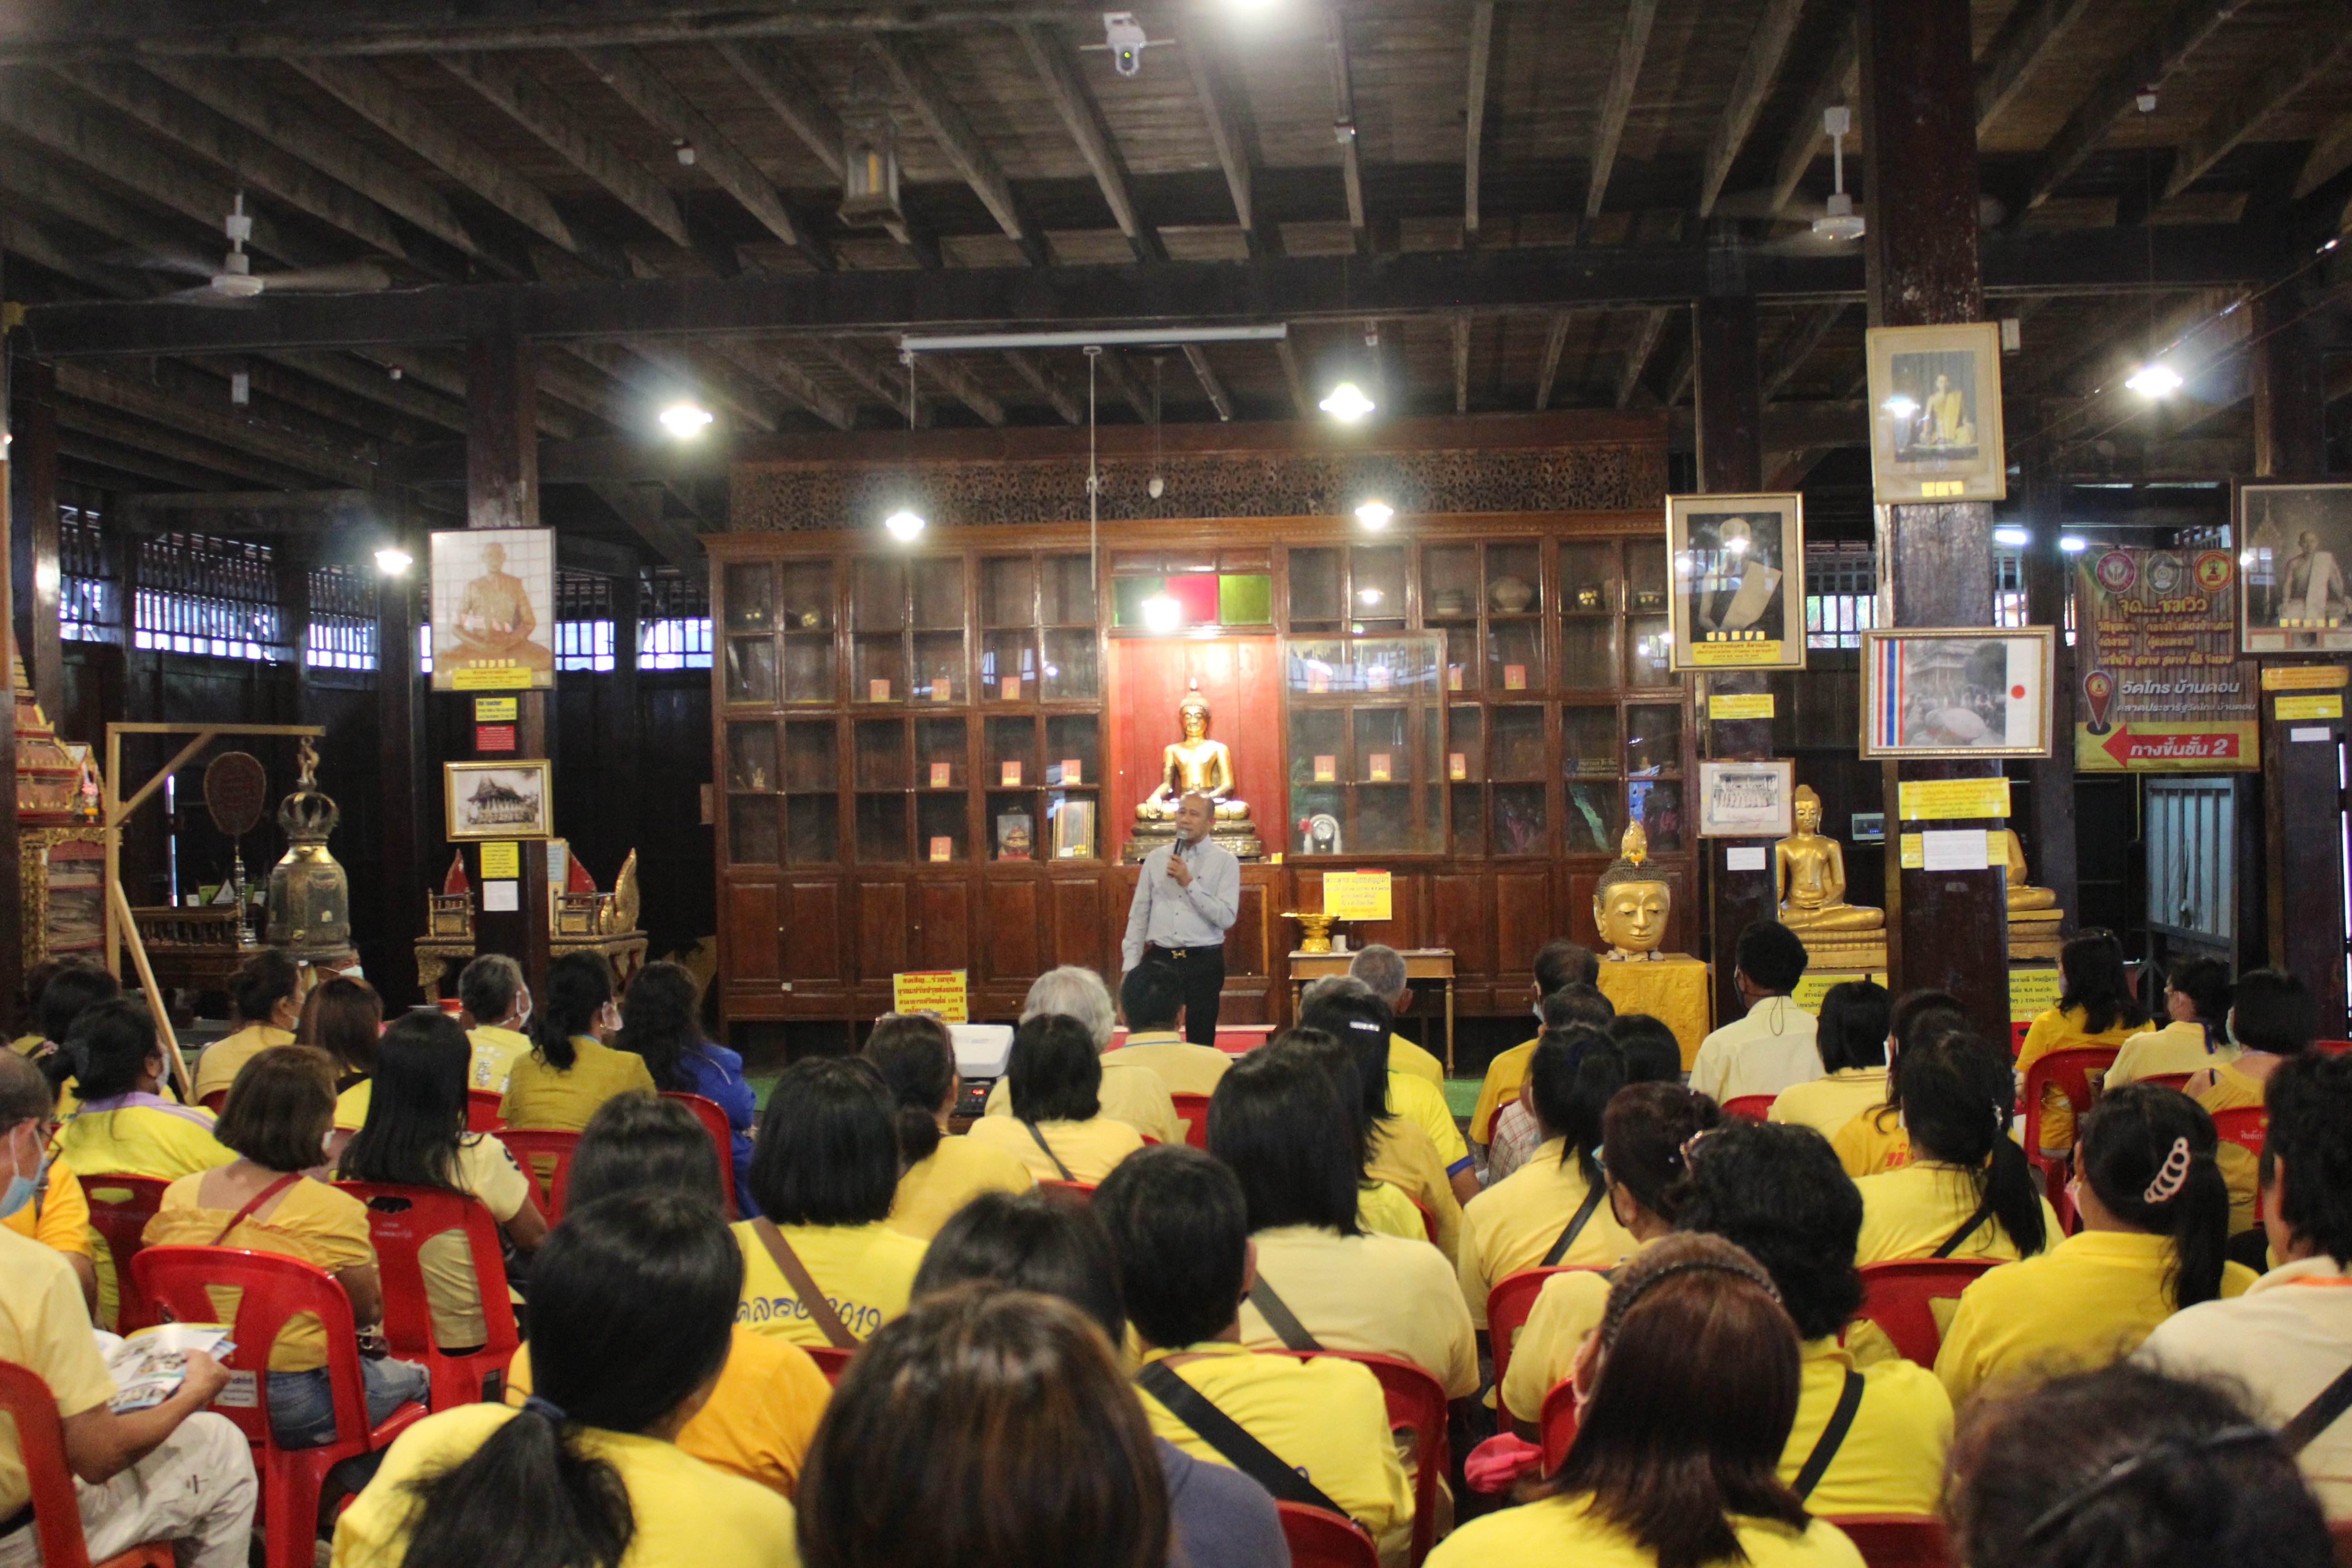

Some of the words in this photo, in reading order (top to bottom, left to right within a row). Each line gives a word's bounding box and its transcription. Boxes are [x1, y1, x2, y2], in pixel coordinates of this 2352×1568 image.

[2175, 680, 2239, 693] บ้านดอน
[2130, 736, 2208, 756] ทางขึ้นชั้น
[2212, 739, 2228, 755] 2
